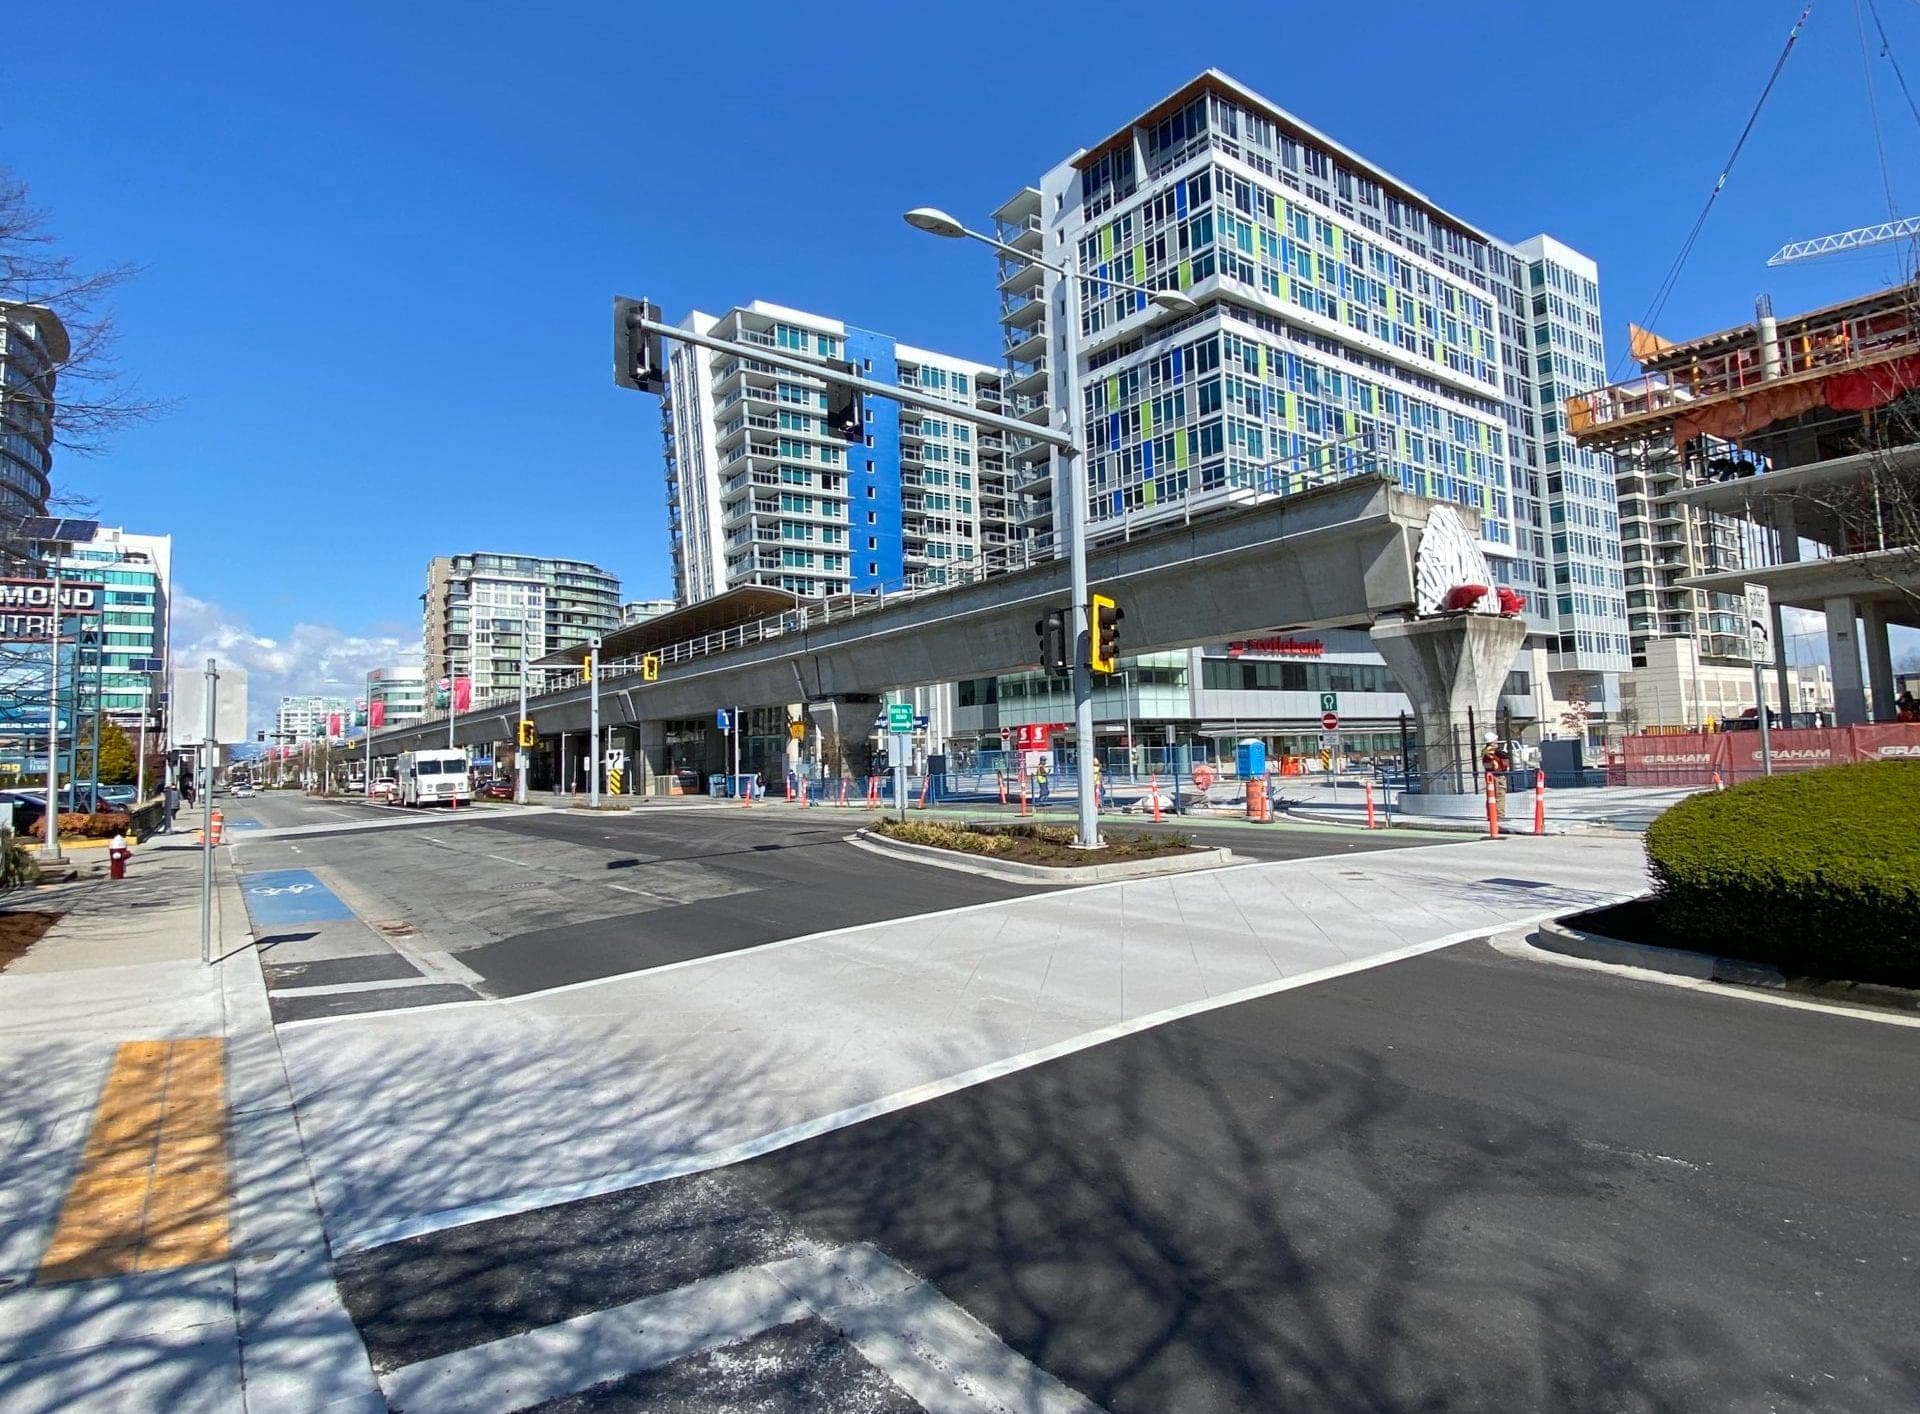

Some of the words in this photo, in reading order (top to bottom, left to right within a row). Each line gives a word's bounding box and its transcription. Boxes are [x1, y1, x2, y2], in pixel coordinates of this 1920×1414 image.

[0, 585, 95, 607] MOND
[1643, 754, 1711, 764] GRAHAM
[1752, 748, 1831, 760] GRAHAM
